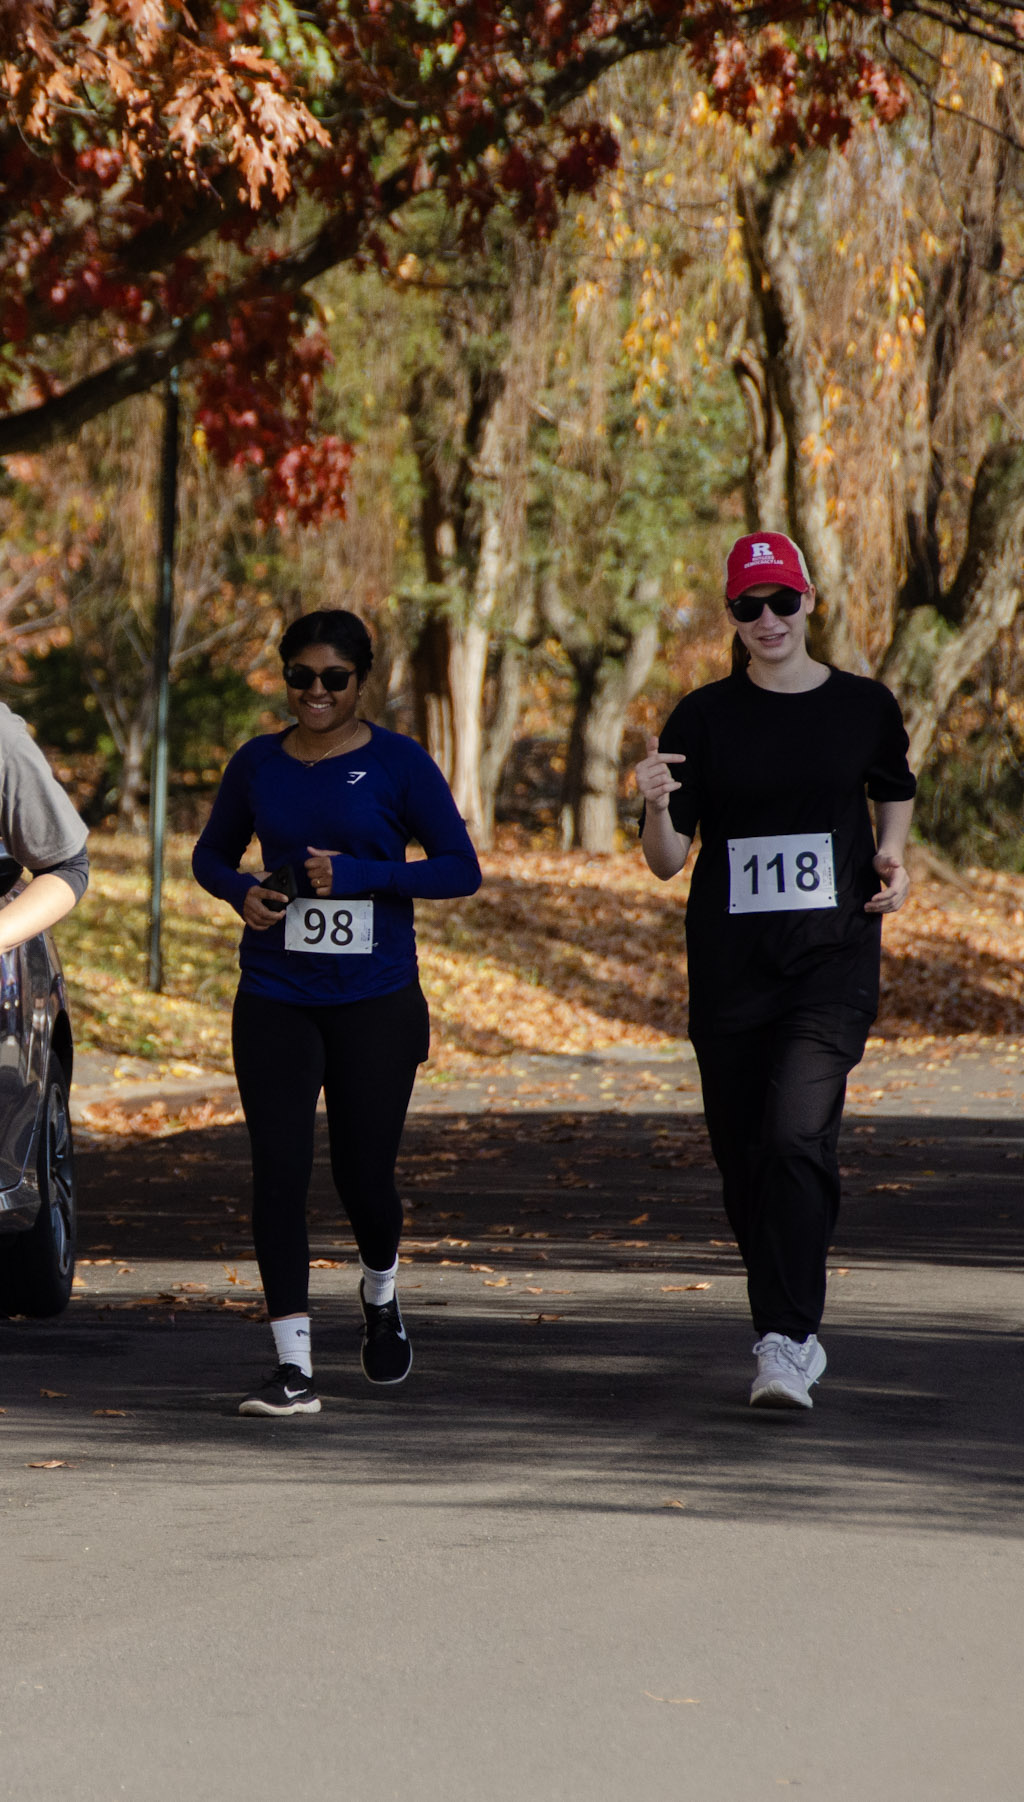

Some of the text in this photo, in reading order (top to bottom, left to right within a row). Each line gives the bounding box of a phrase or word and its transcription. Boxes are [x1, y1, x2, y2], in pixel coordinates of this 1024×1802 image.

[751, 542, 773, 557] R
[743, 851, 820, 895] 118
[303, 908, 354, 946] 98
